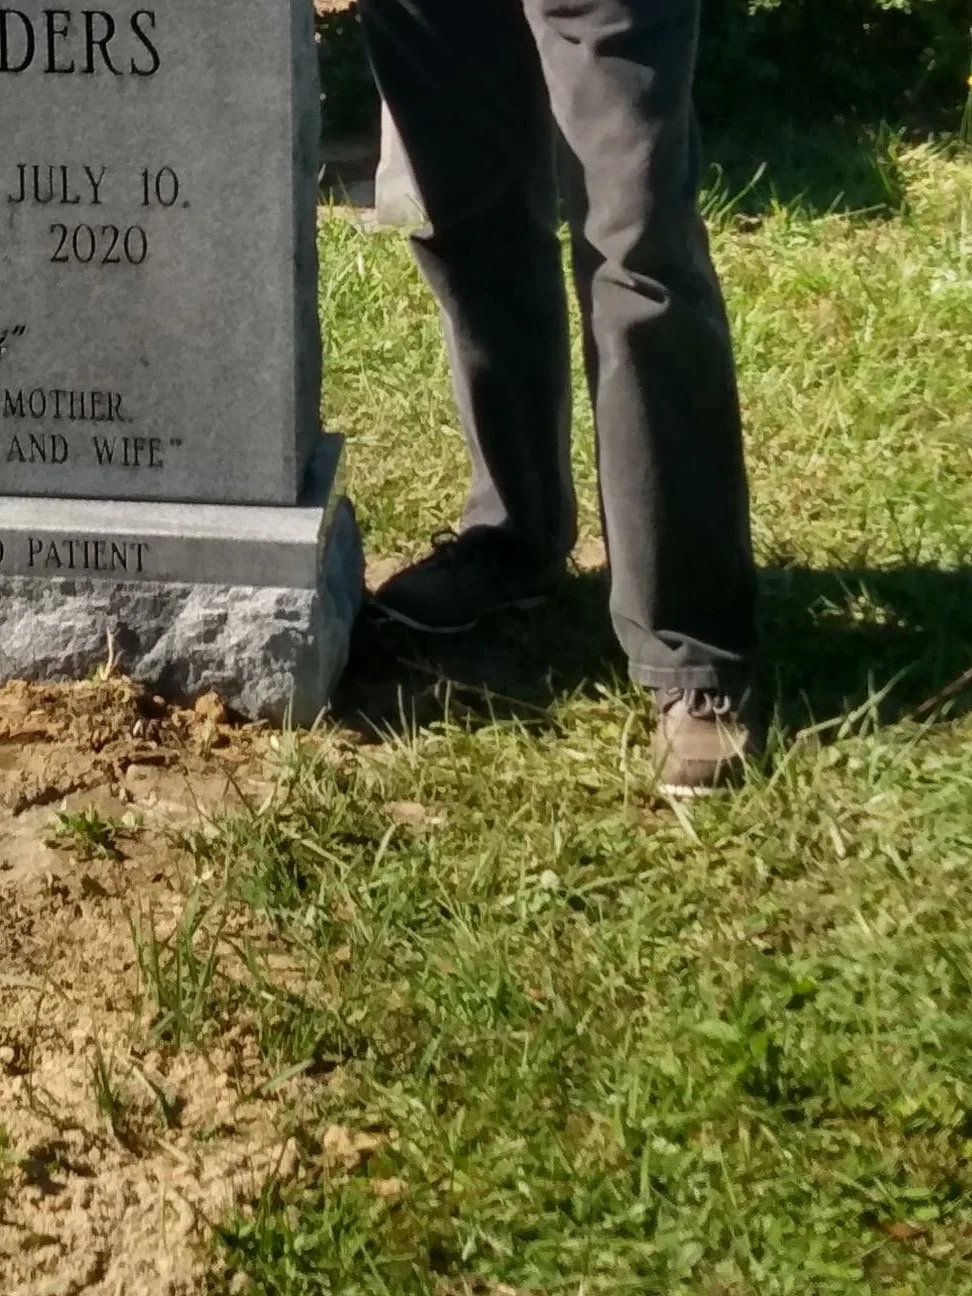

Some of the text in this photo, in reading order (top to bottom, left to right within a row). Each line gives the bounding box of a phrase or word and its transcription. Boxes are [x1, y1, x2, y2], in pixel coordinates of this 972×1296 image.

[7, 162, 108, 206] JULY
[49, 222, 149, 266] 2020
[6, 432, 69, 465] AND
[27, 536, 150, 573] PATIENT
